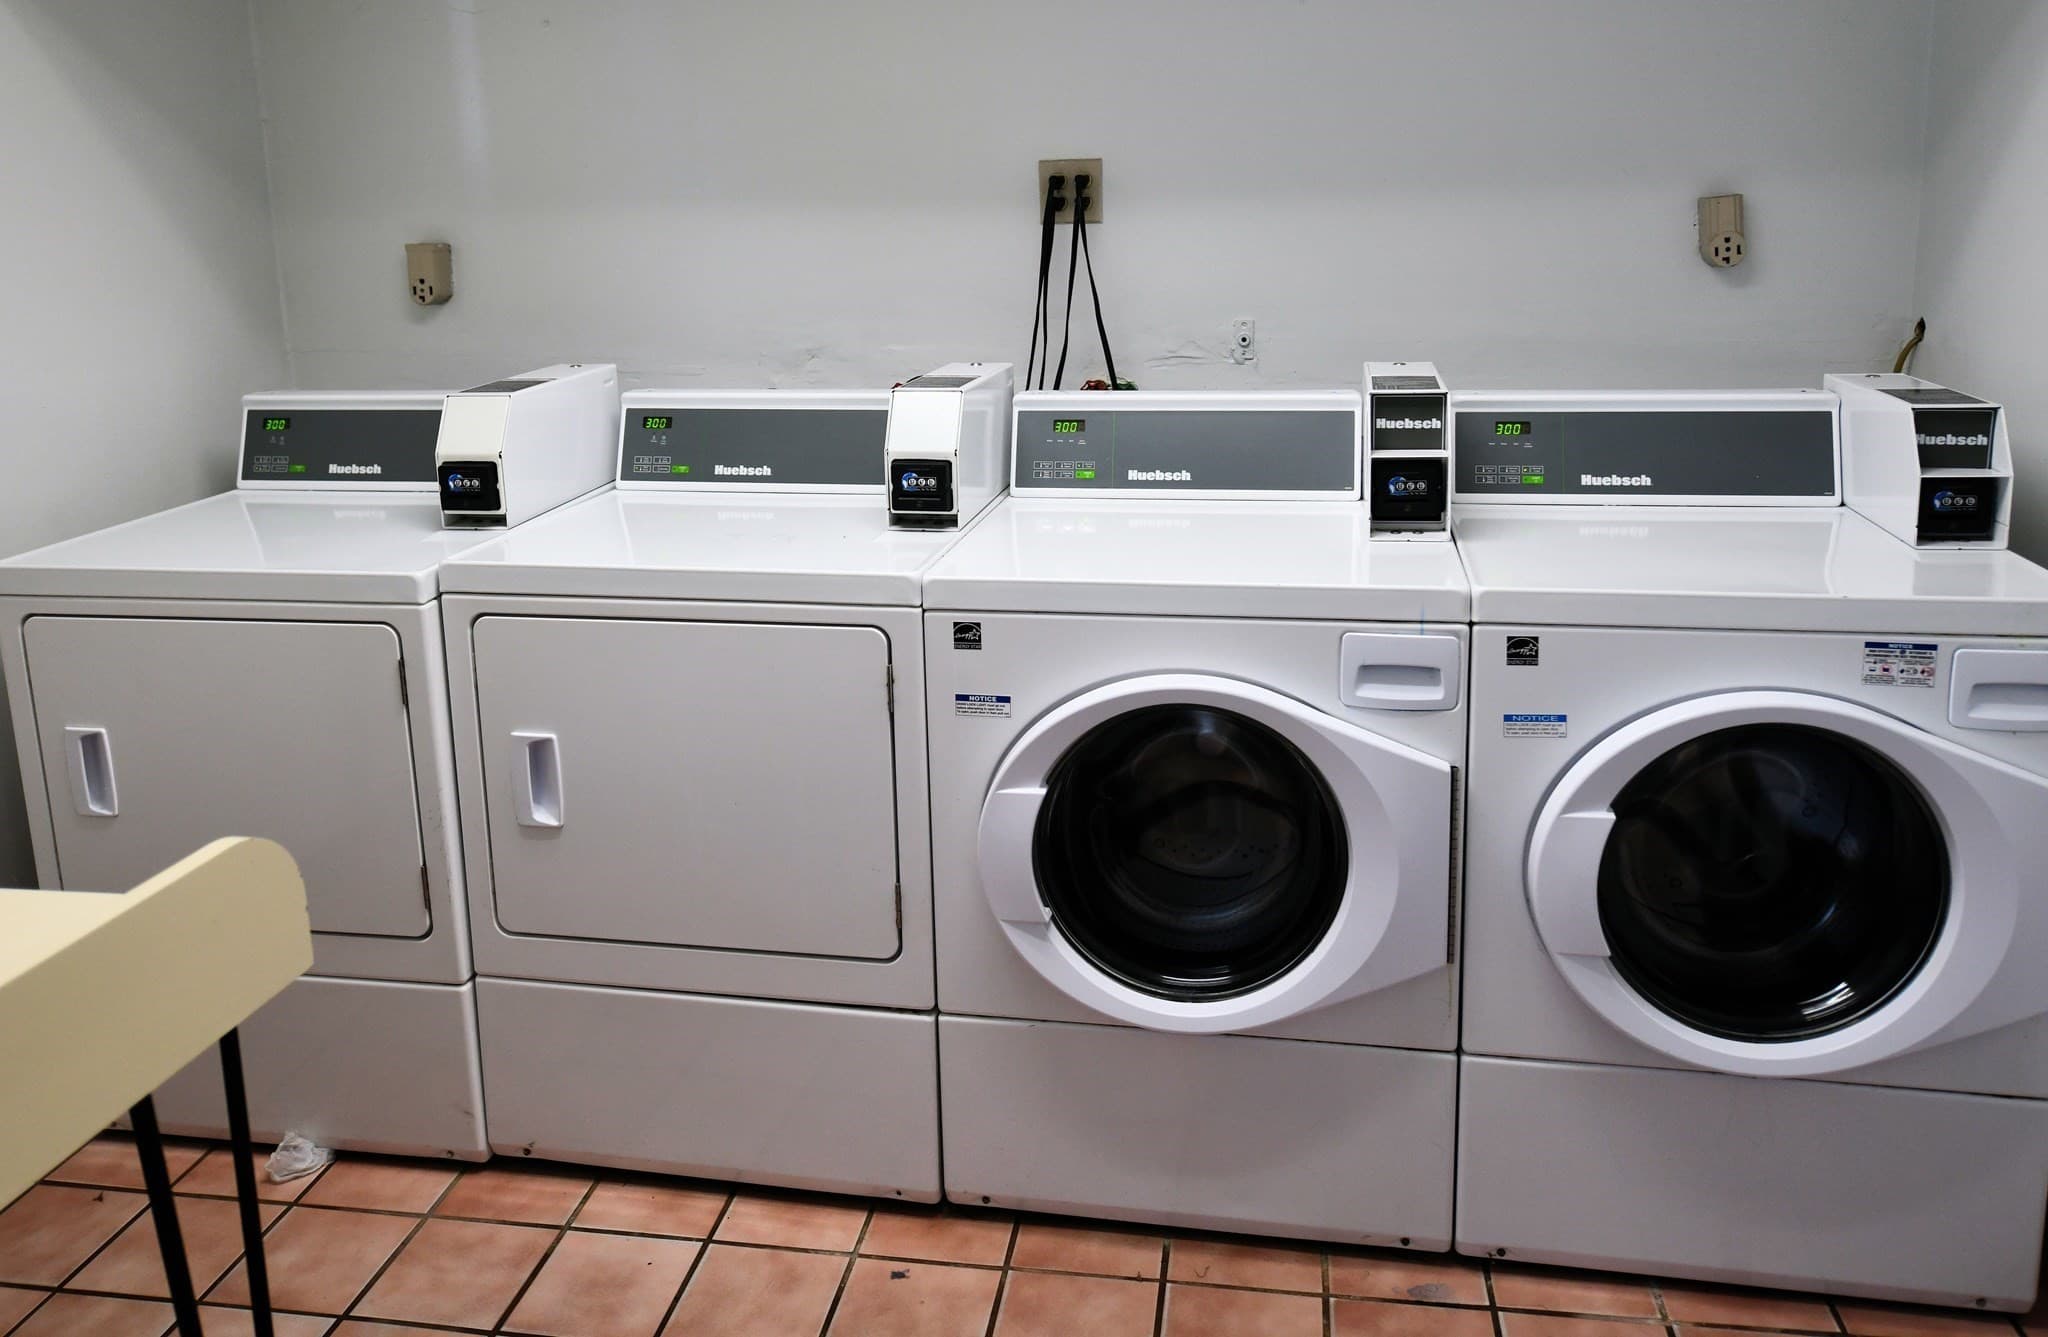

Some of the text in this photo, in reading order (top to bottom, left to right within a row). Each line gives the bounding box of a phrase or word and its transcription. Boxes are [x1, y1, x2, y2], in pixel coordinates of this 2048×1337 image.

[265, 419, 286, 430] 300
[645, 418, 667, 429] 300
[1055, 421, 1078, 433] 300
[1375, 417, 1442, 429] Huebsch
[1496, 423, 1521, 435] 300
[1916, 433, 1989, 446] Huebsch
[328, 463, 382, 475] Huebsch
[714, 464, 772, 476] Huebsch
[1127, 470, 1192, 481] Huebsch
[1580, 474, 1652, 486] Huebsch
